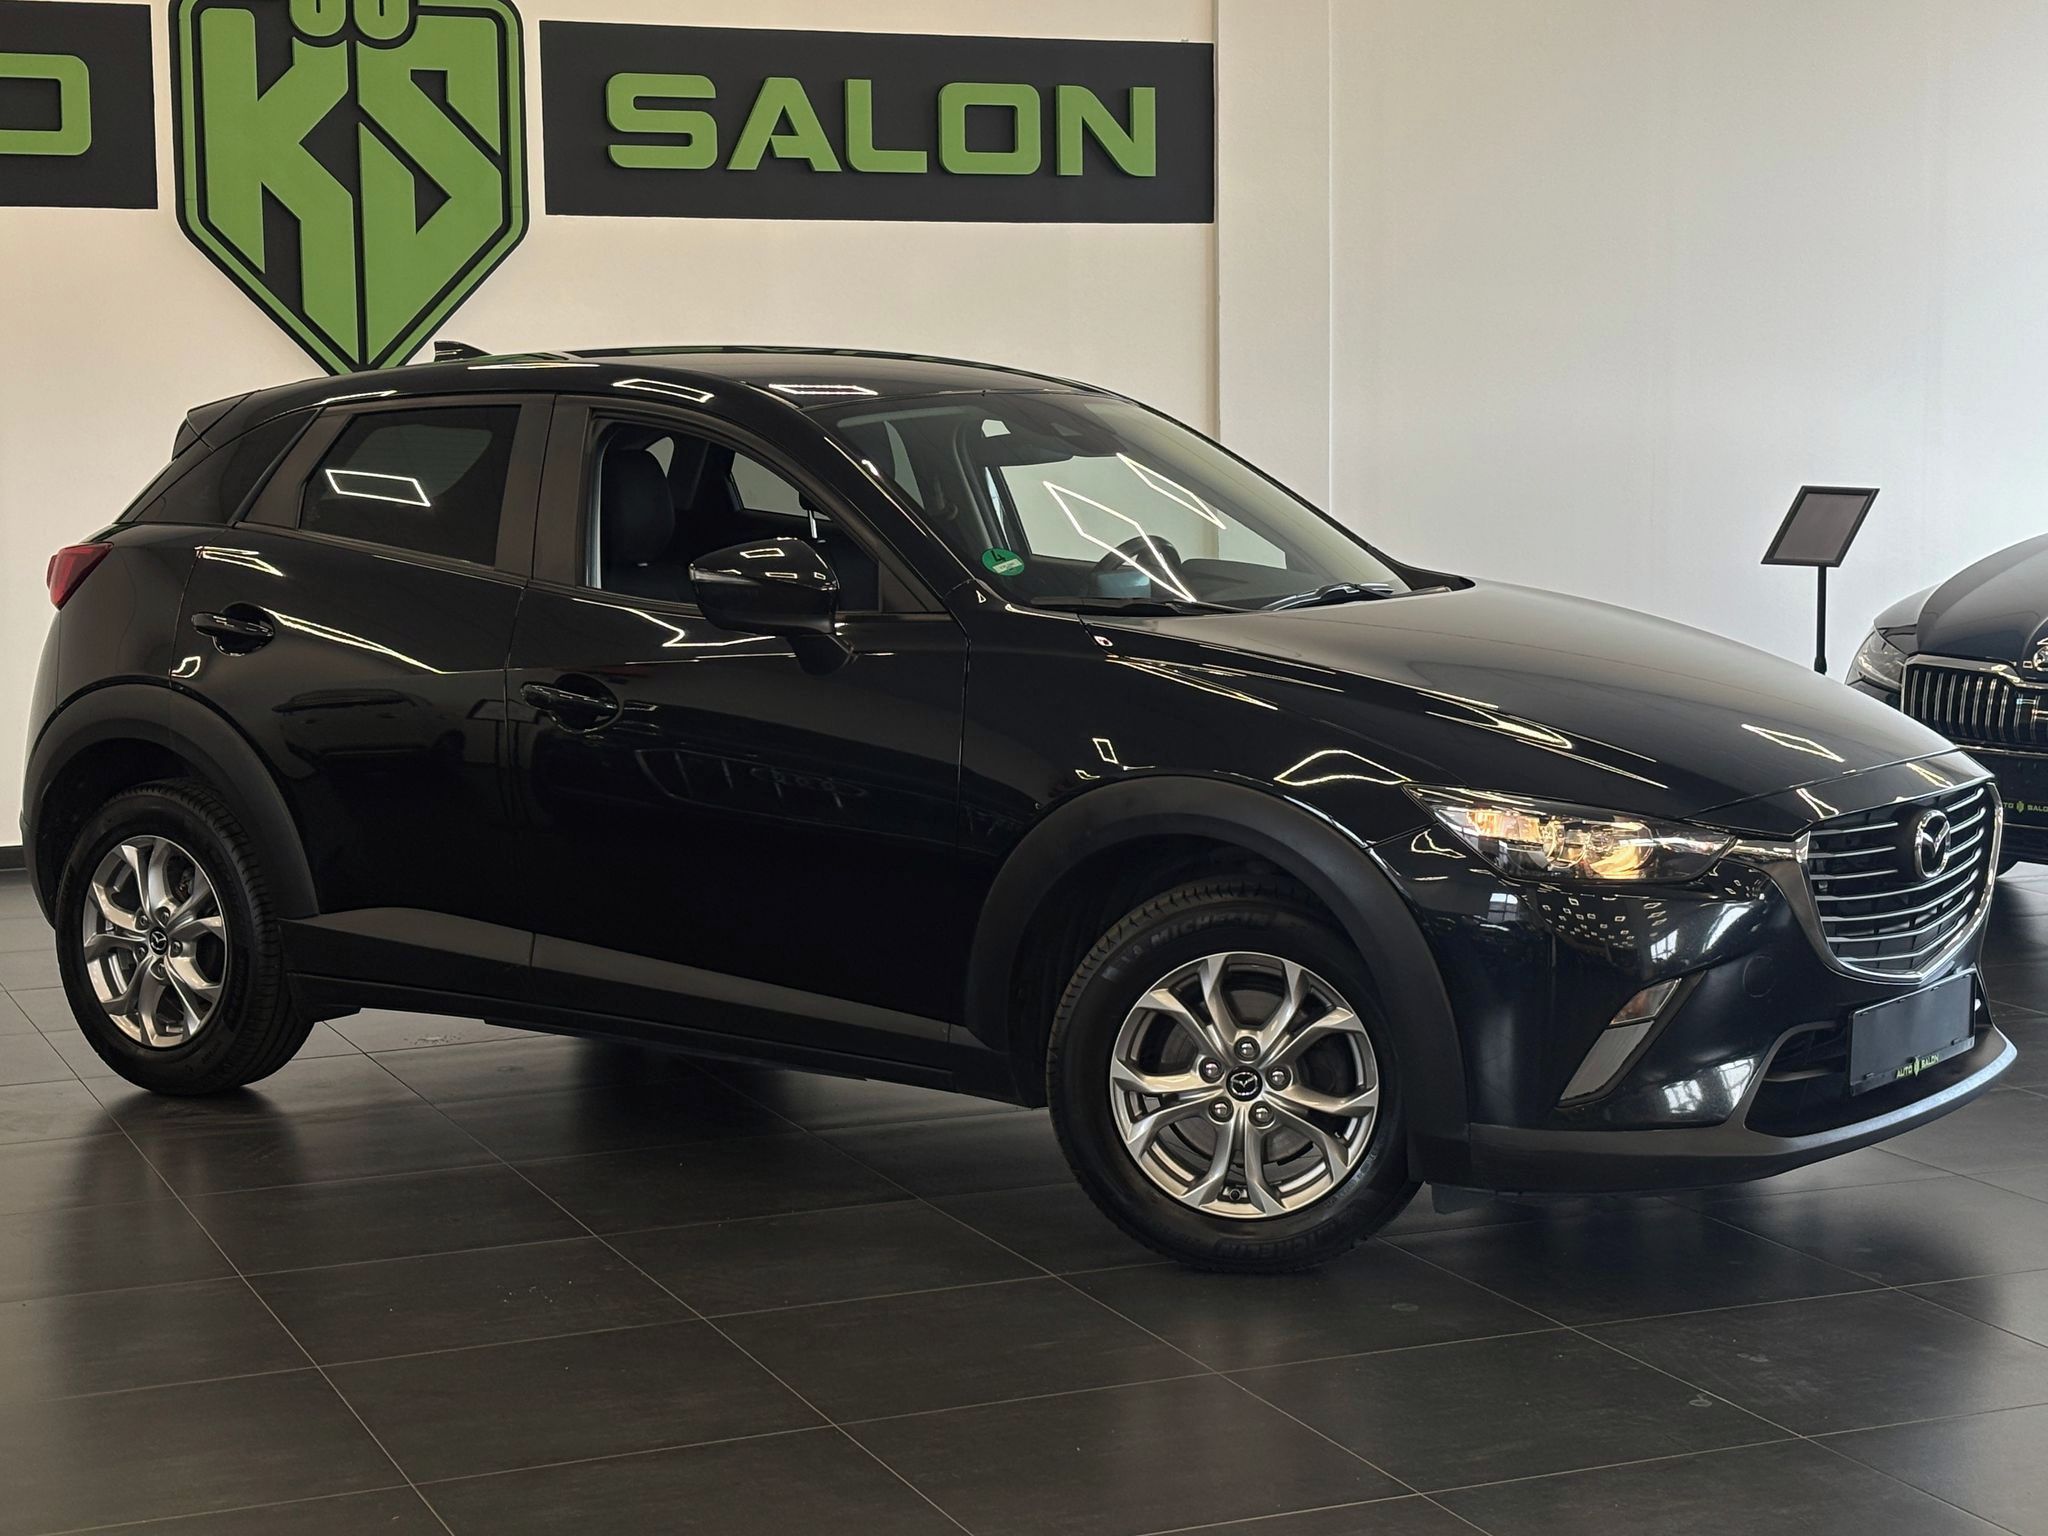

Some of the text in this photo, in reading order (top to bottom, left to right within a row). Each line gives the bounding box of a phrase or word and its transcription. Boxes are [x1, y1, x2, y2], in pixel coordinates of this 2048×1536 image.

[605, 72, 1156, 177] SALON
[1896, 1054, 1939, 1079] AUTO SALON
